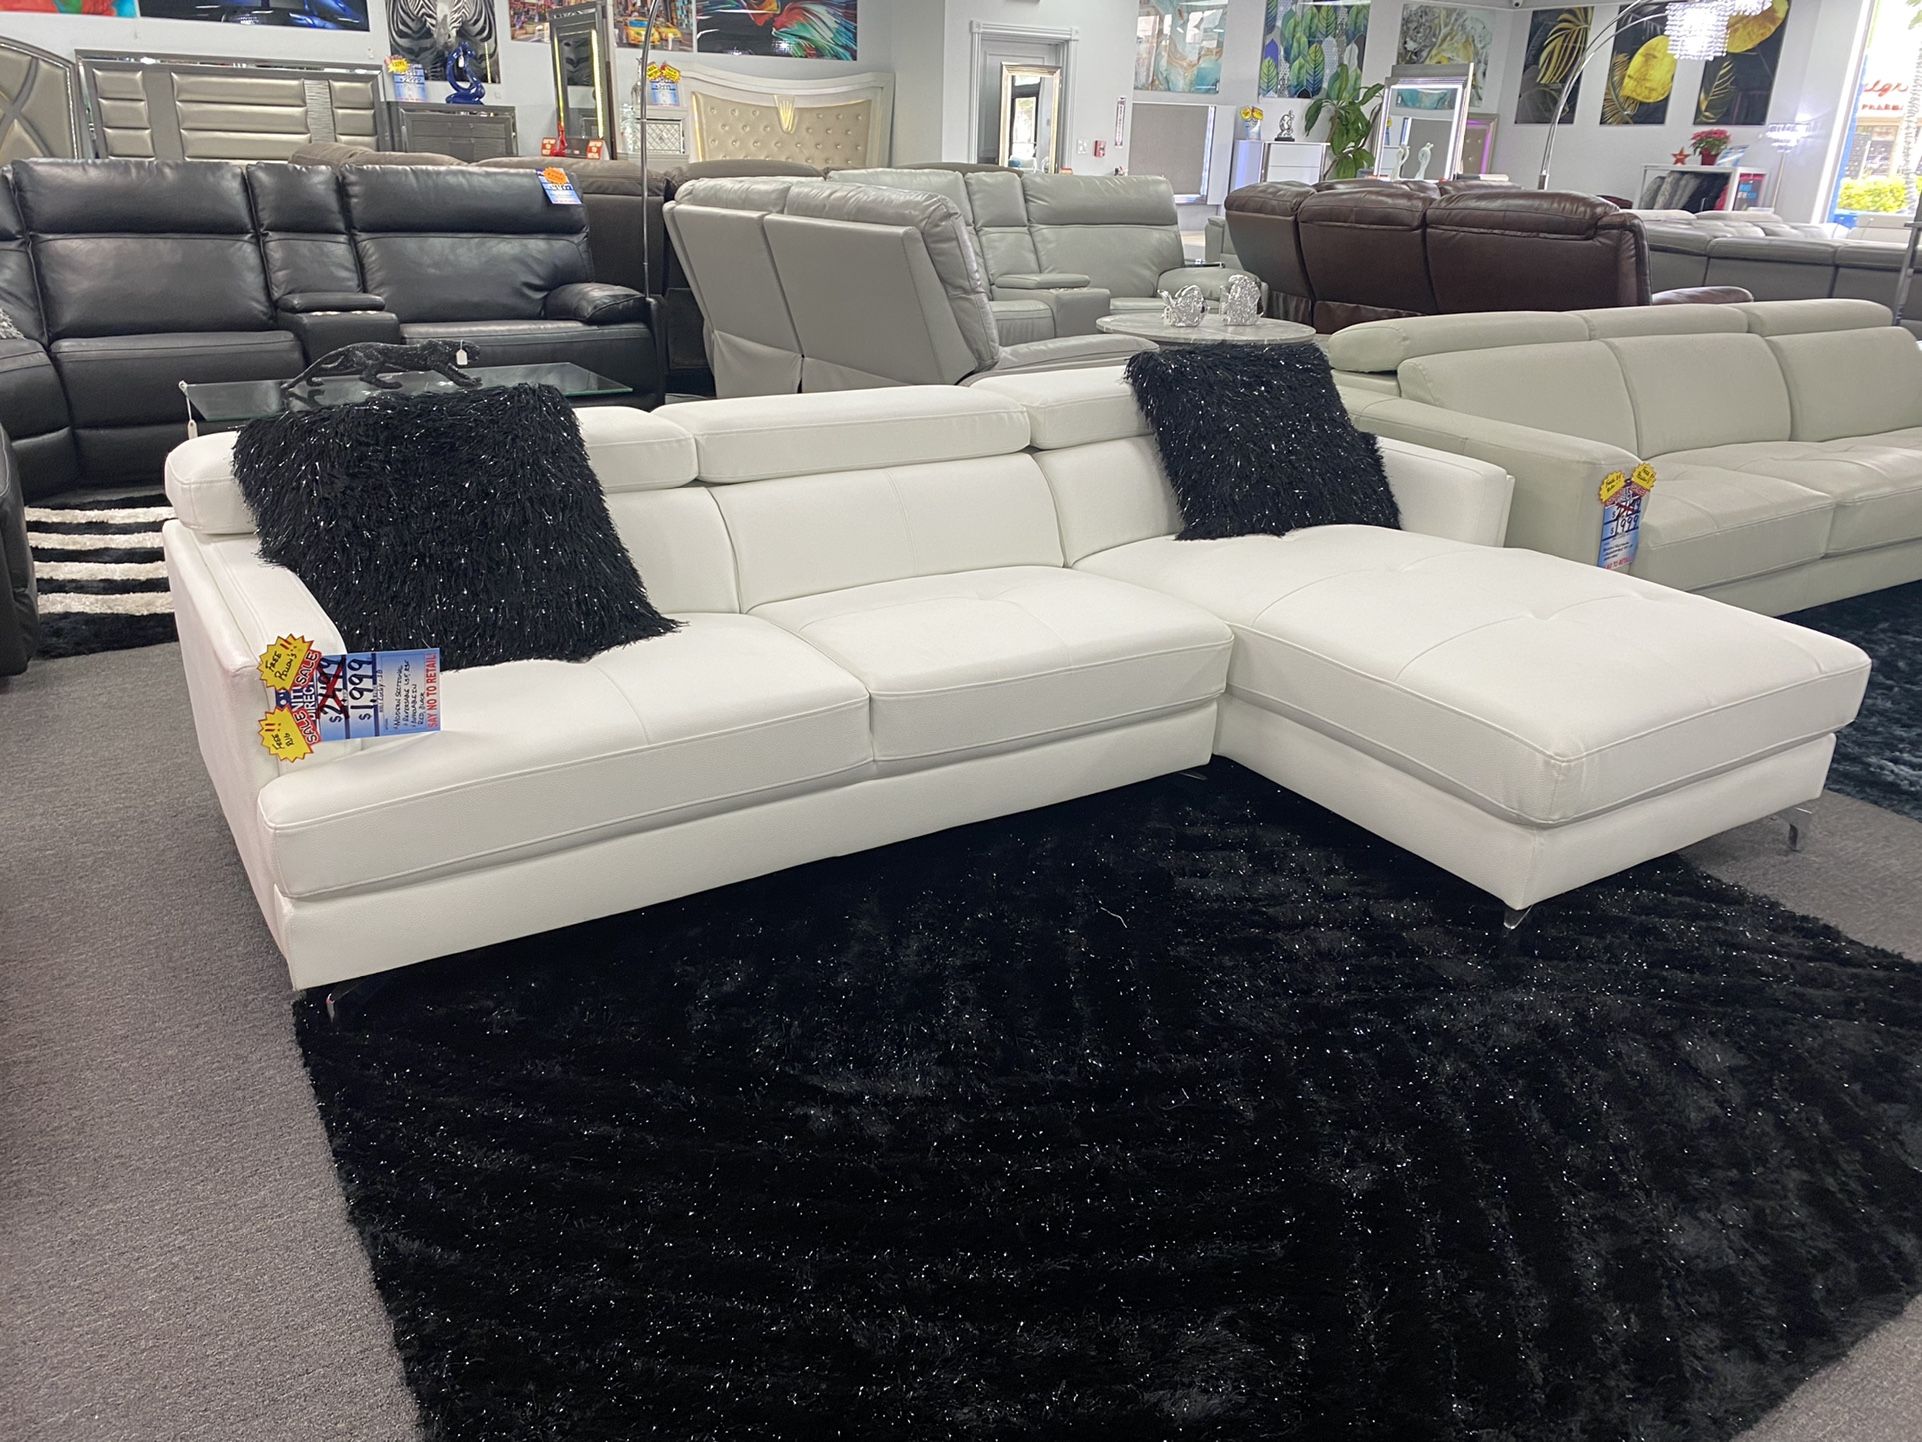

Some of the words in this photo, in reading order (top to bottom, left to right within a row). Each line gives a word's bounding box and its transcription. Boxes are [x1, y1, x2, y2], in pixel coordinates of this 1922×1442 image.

[265, 651, 283, 673] FREE
[296, 651, 318, 686] SALE
[426, 685, 438, 697] TO
[426, 699, 438, 711] NO
[294, 710, 319, 745] SALE
[427, 712, 438, 729] SAY
[272, 729, 286, 751] FREE
